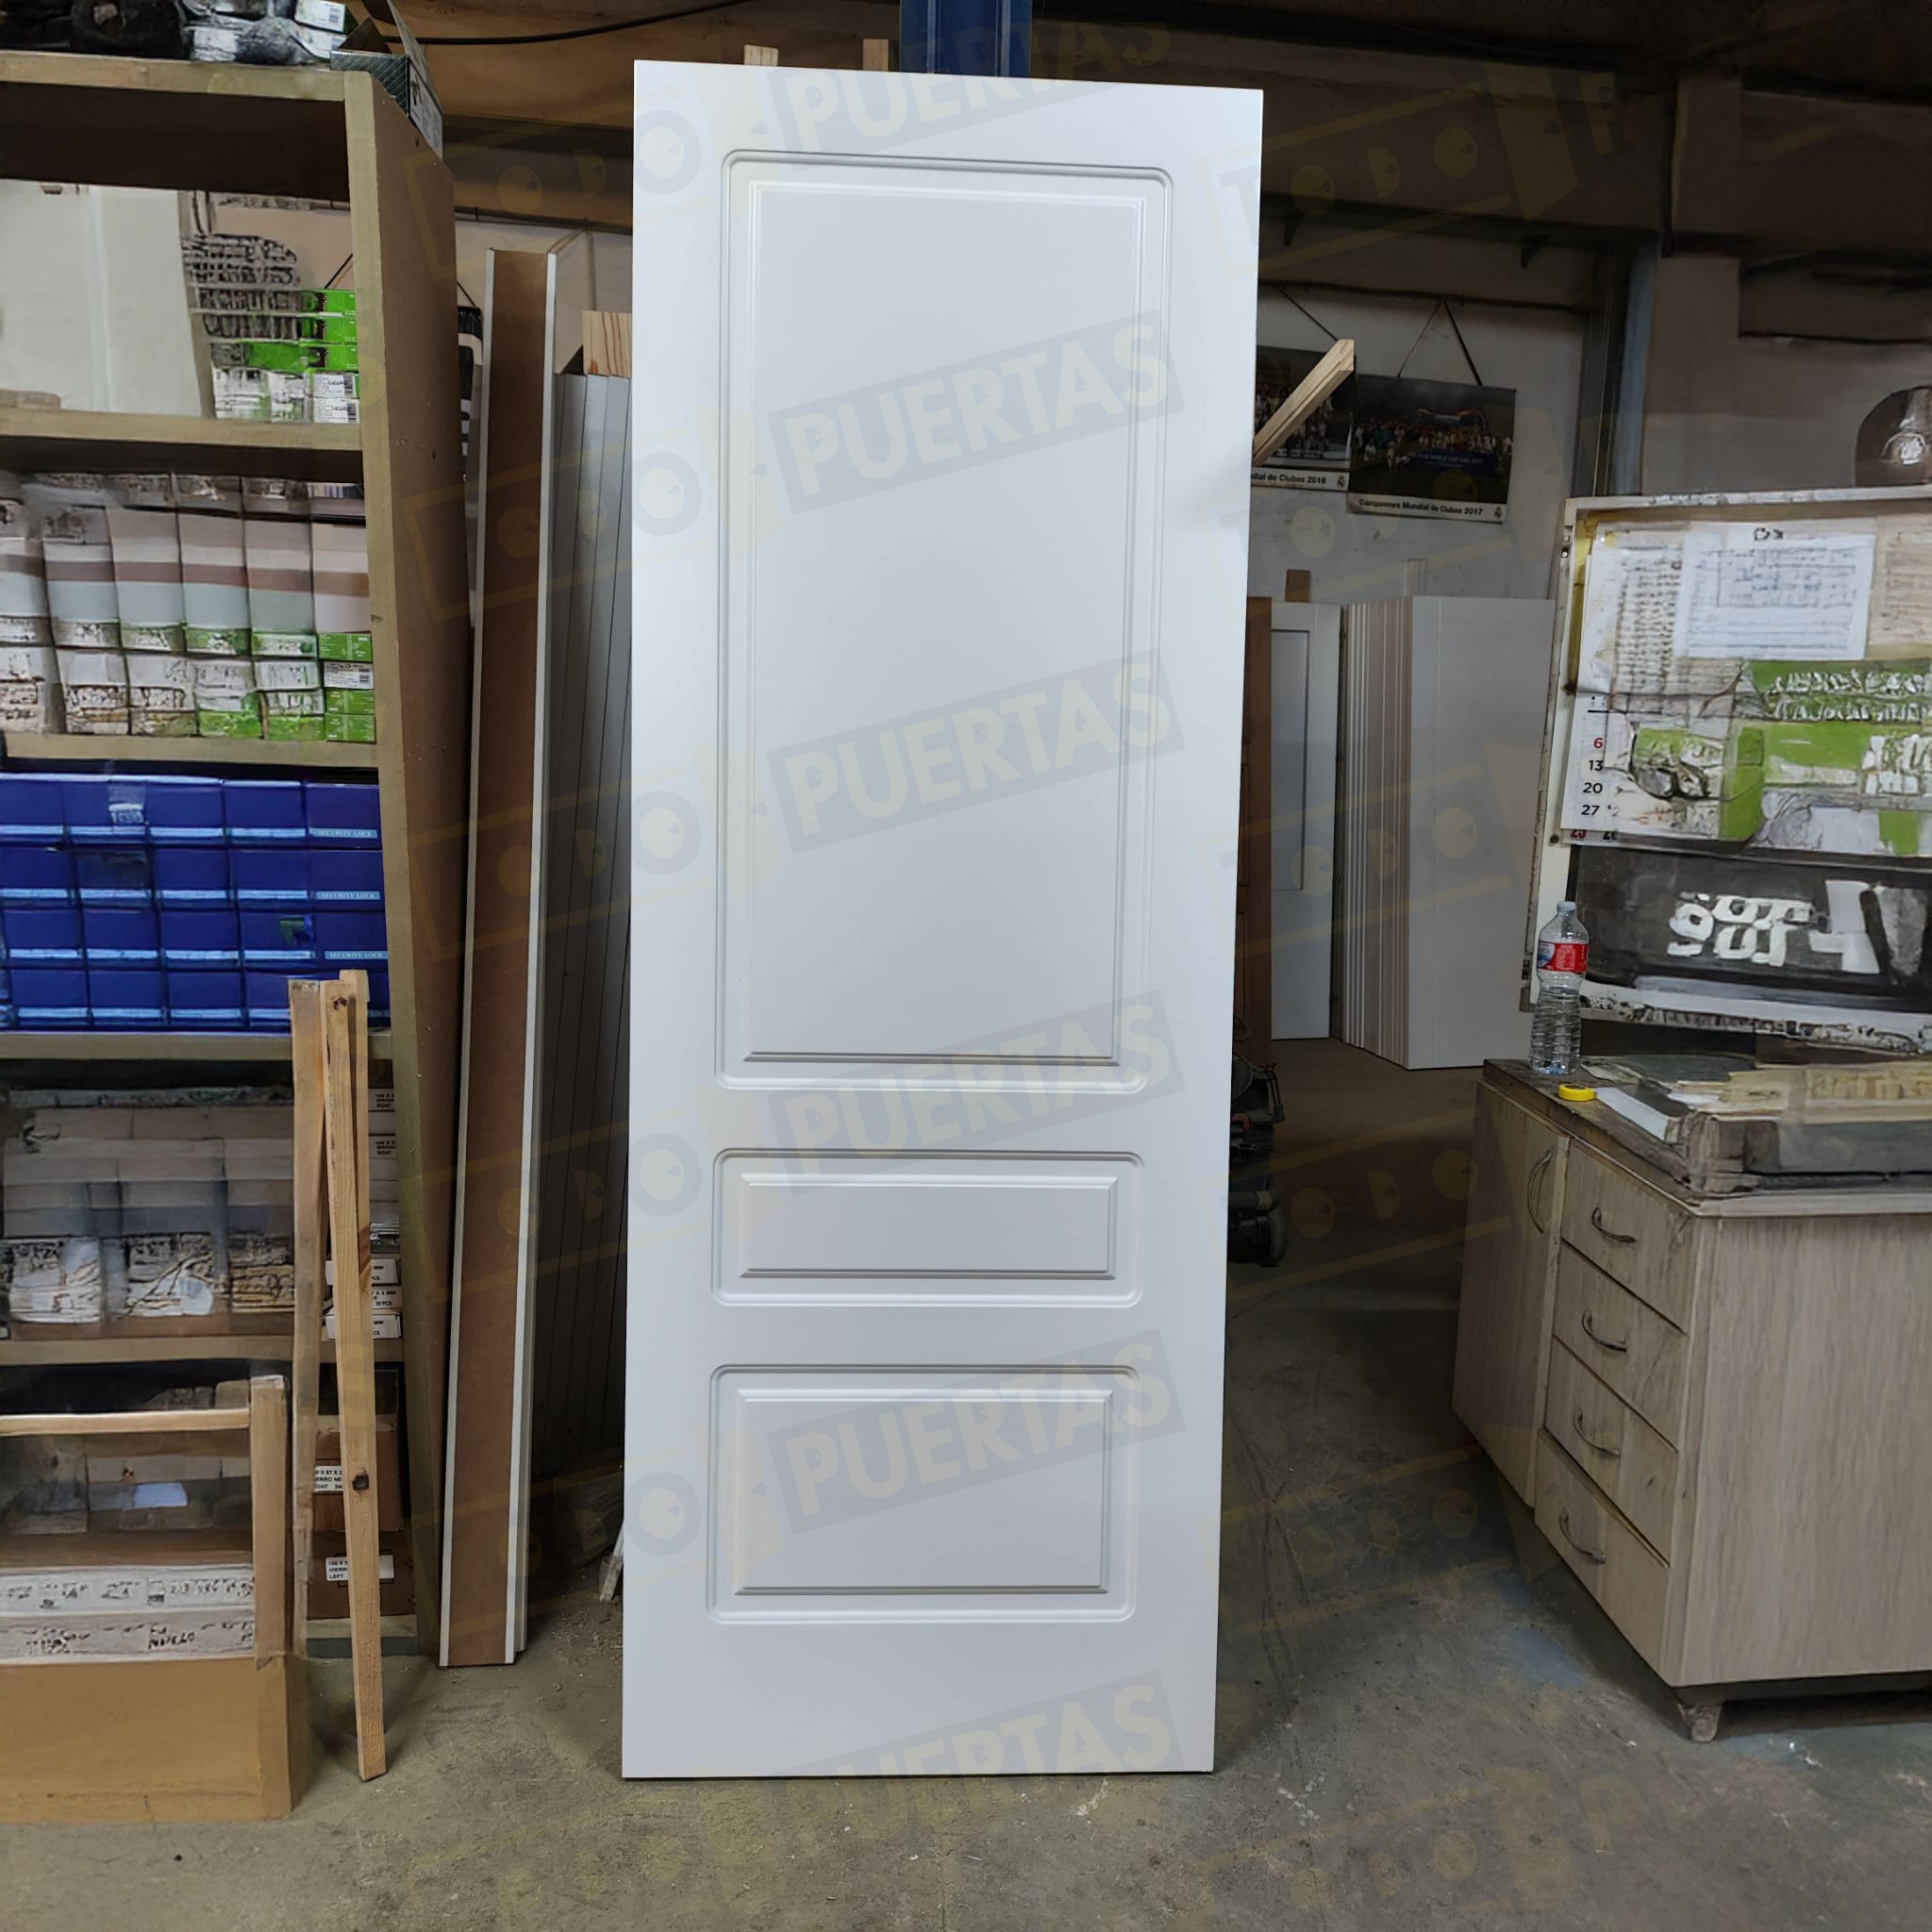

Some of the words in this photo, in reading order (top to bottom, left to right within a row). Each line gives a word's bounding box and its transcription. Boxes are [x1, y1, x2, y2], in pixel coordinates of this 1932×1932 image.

[1359, 498, 1400, 508] Campeones
[1403, 502, 1429, 510] Mundial
[1440, 506, 1462, 514] Clubes
[1464, 507, 1483, 515] 2017
[1593, 738, 1604, 749] 6
[1589, 759, 1604, 772] 13
[1583, 782, 1603, 793] 20
[1581, 805, 1600, 816] 27
